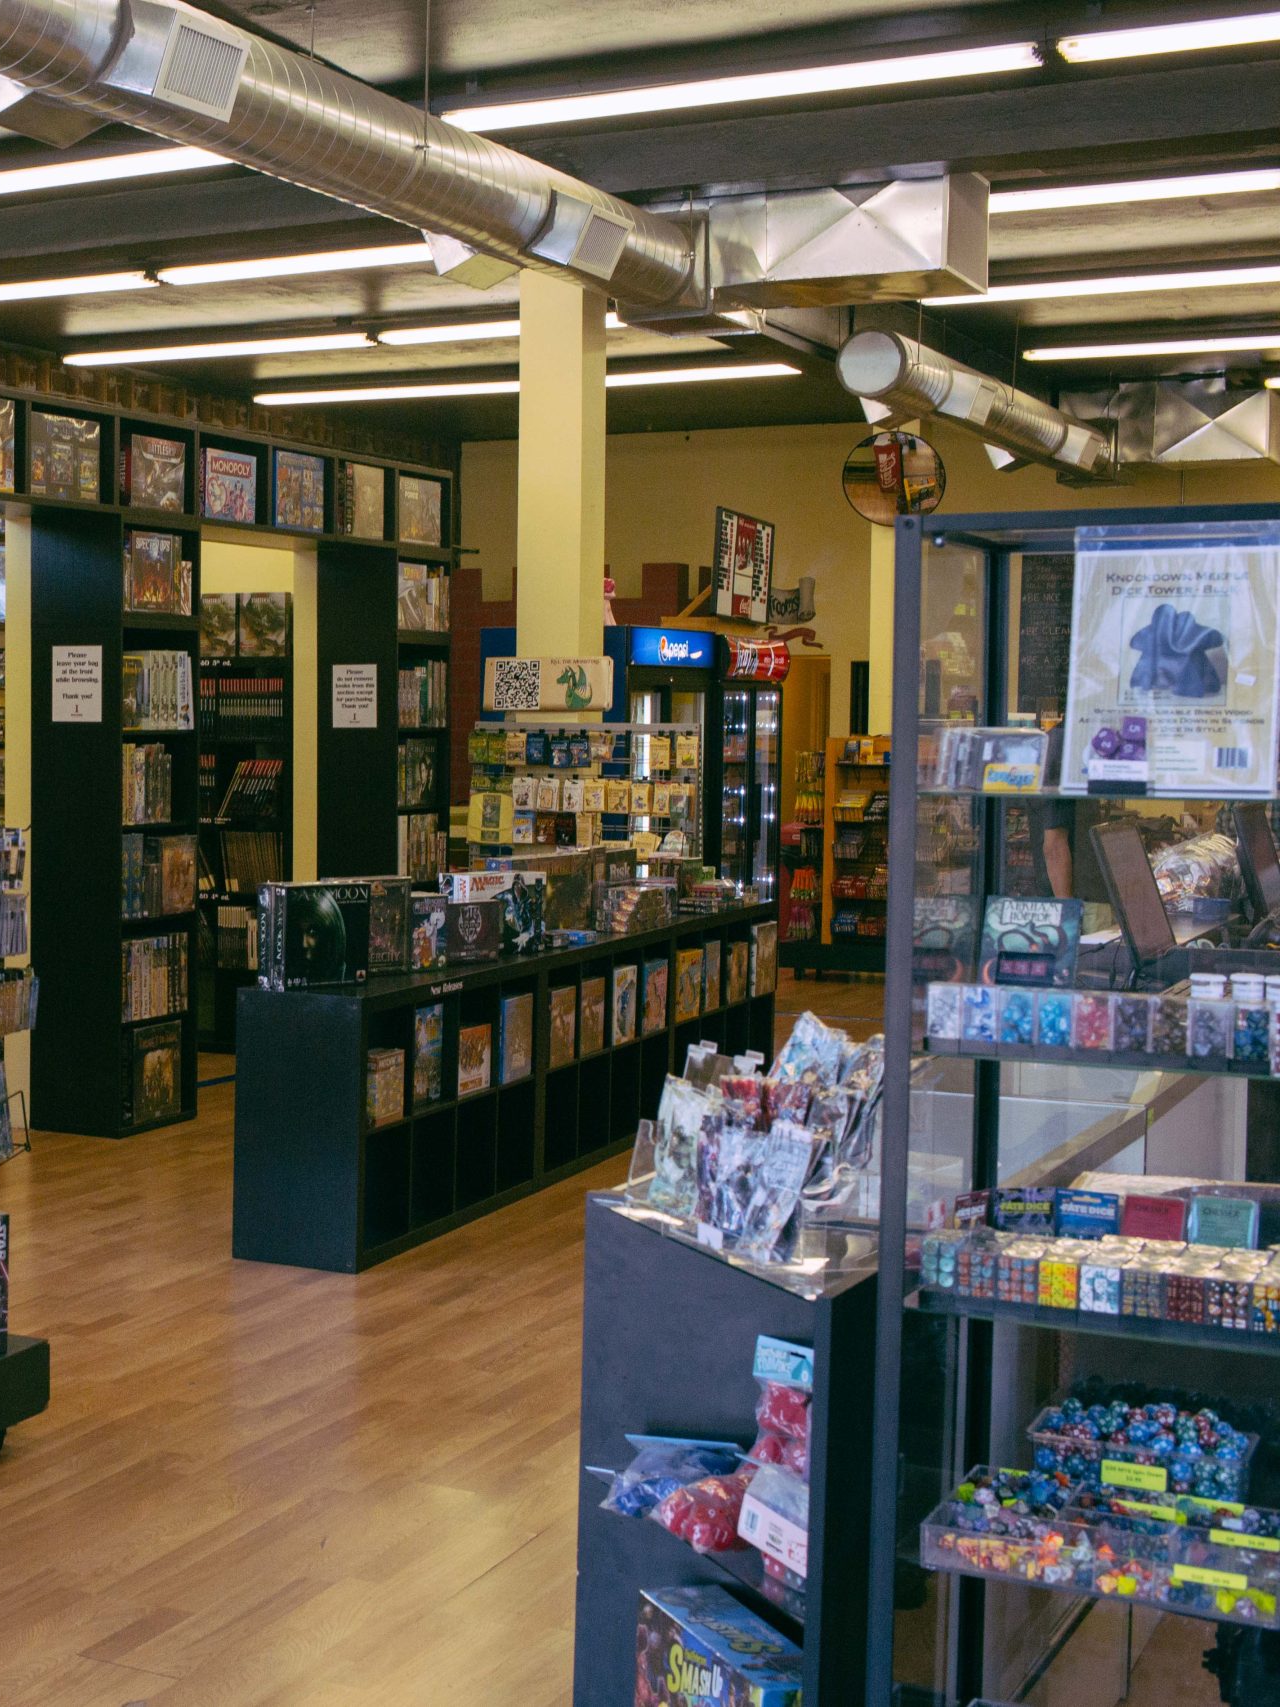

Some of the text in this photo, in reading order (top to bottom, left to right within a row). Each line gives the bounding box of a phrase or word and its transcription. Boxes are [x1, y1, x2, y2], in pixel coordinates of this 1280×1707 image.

[212, 459, 252, 475] MONOPOLY
[668, 641, 689, 661] pepsi
[88, 660, 99, 668] bag
[81, 693, 93, 701] you!
[609, 864, 630, 880] Risk
[470, 875, 505, 892] MAGIC
[330, 886, 369, 901] MOON
[1024, 1201, 1051, 1212] DICE
[1088, 1205, 1115, 1216] DICE
[666, 1643, 724, 1698] SMASH UP
